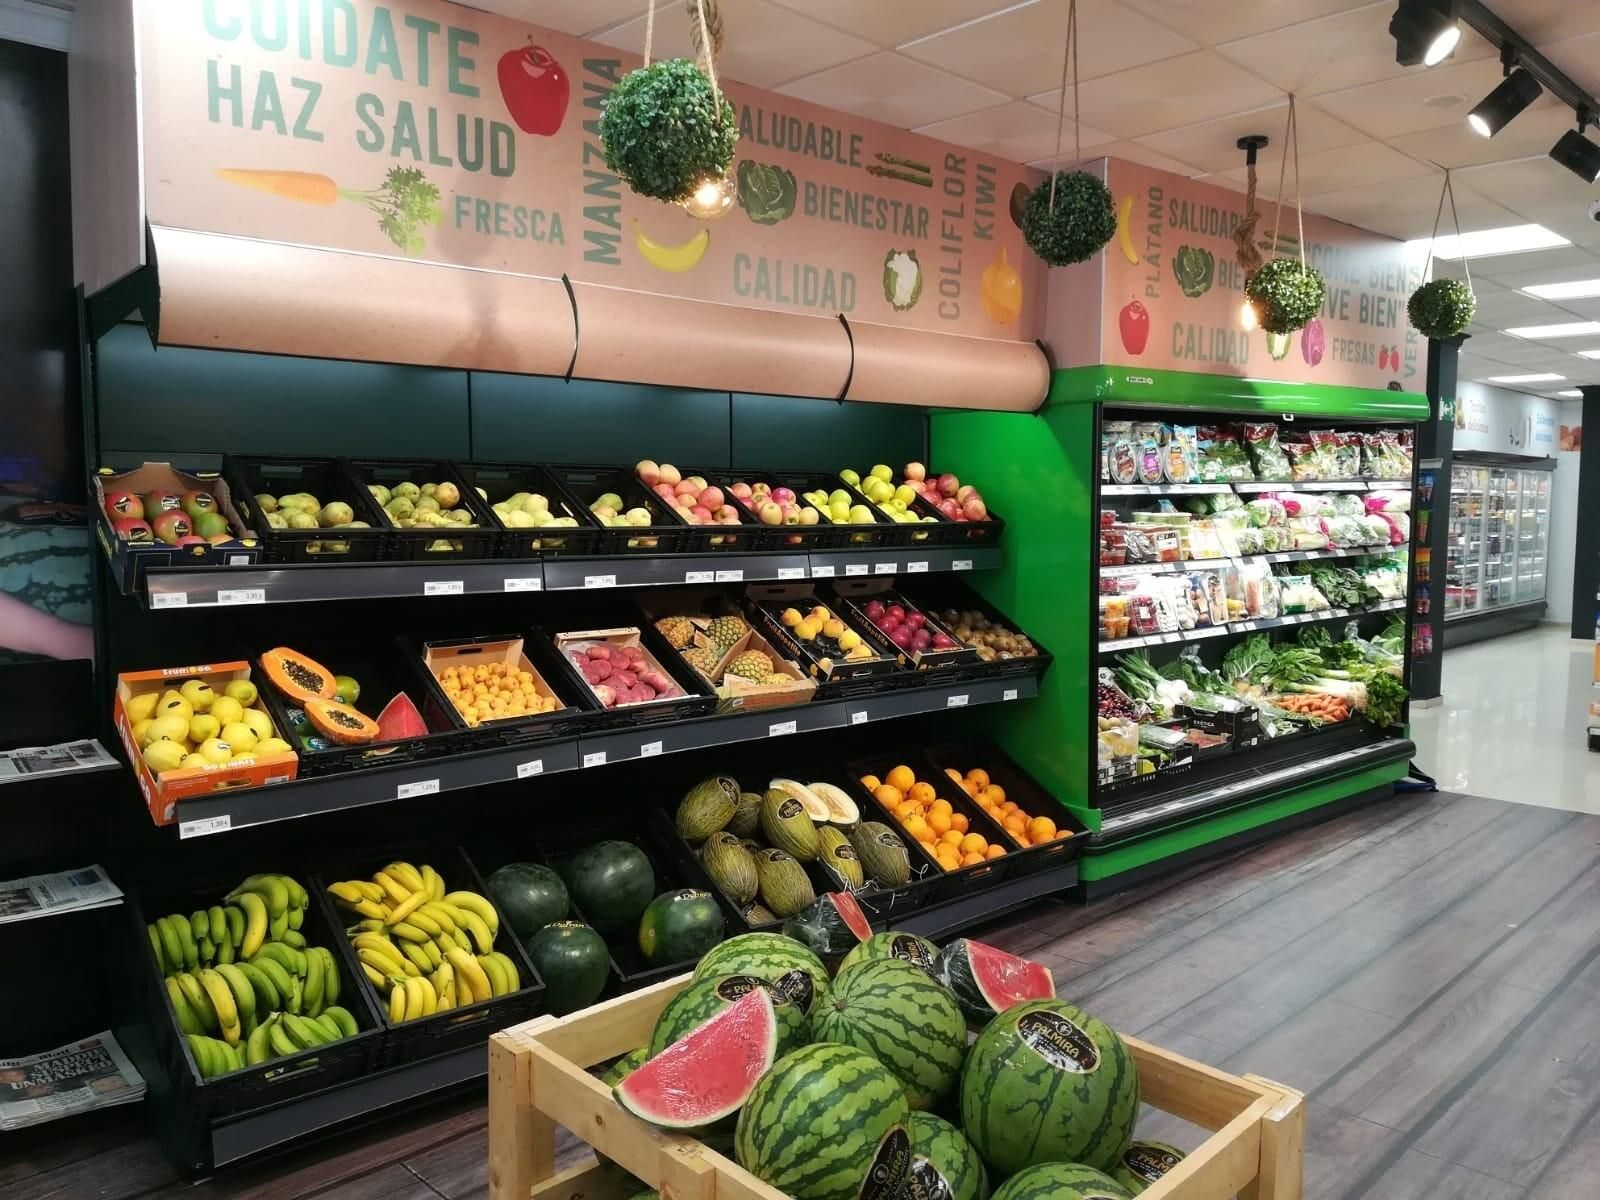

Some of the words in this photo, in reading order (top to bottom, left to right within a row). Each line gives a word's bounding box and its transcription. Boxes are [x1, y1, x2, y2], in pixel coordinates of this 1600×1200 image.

[201, 0, 481, 99] CUIDATE
[207, 60, 324, 142] HAZ
[356, 93, 515, 178] SALUD
[739, 104, 863, 168] ALUDABLE
[455, 197, 565, 245] FRESCA
[804, 181, 930, 240] BIENESTAR
[974, 163, 997, 240] KIWI
[939, 152, 967, 321] COLIFLOR
[1145, 186, 1164, 299] PLÁTANO
[733, 253, 856, 313] CALIDAD
[1368, 256, 1407, 295] BIEN
[1172, 322, 1249, 366] CALIDAD
[1332, 336, 1376, 369] FRESAS
[1032, 1022, 1080, 1058] PALMIRA
